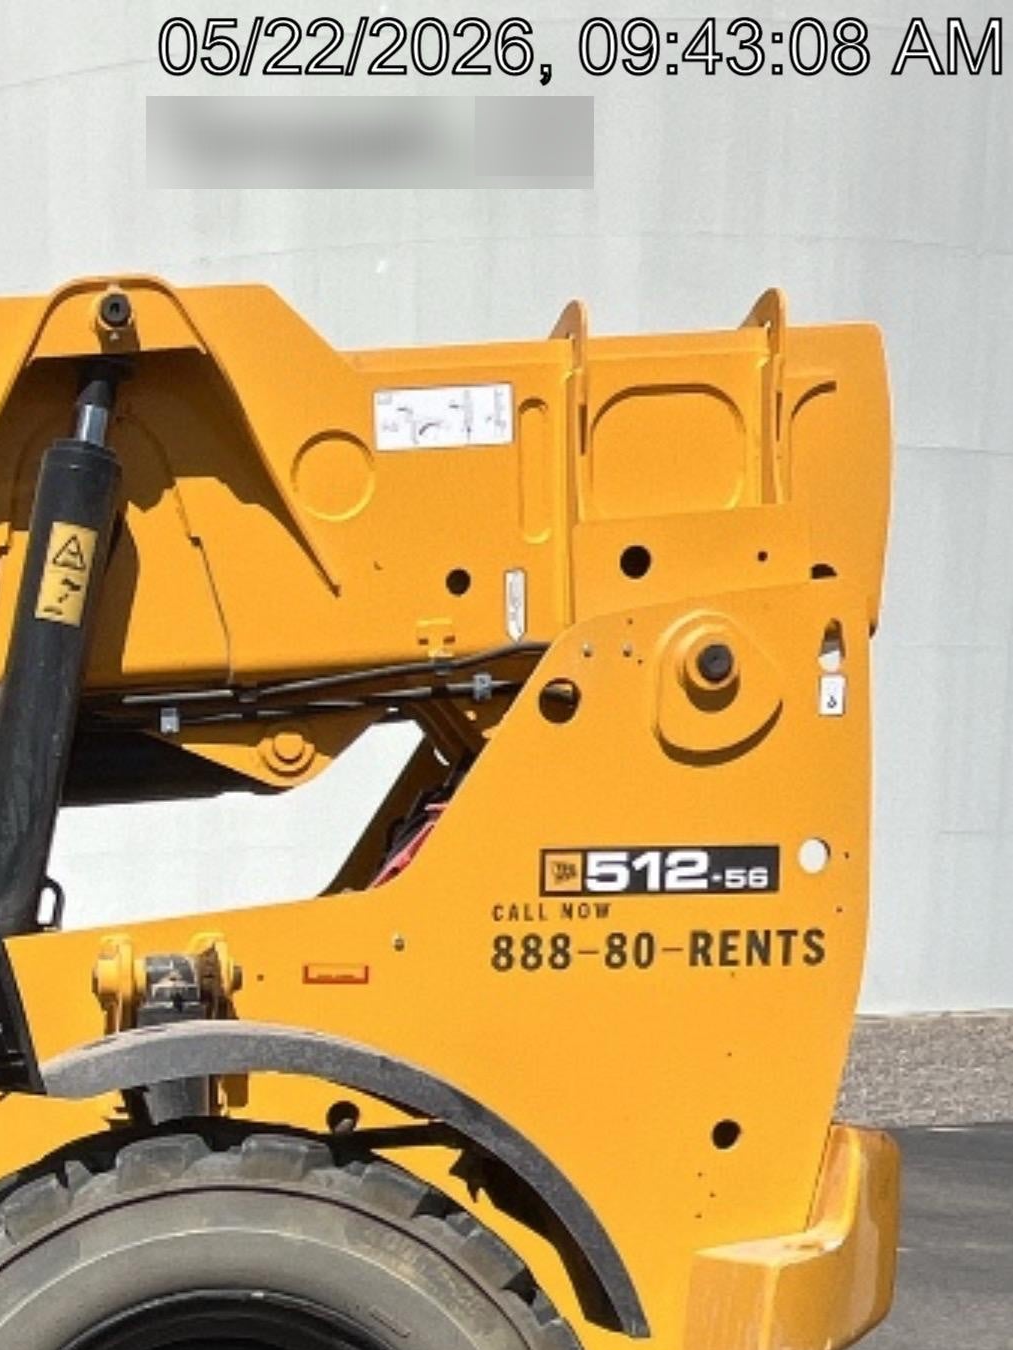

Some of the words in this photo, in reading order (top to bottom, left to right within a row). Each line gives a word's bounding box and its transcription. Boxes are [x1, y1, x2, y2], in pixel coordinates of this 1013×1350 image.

[492, 903, 548, 922] CALL
[560, 902, 611, 920] NOW
[491, 927, 825, 972] 888-80-RENTS
